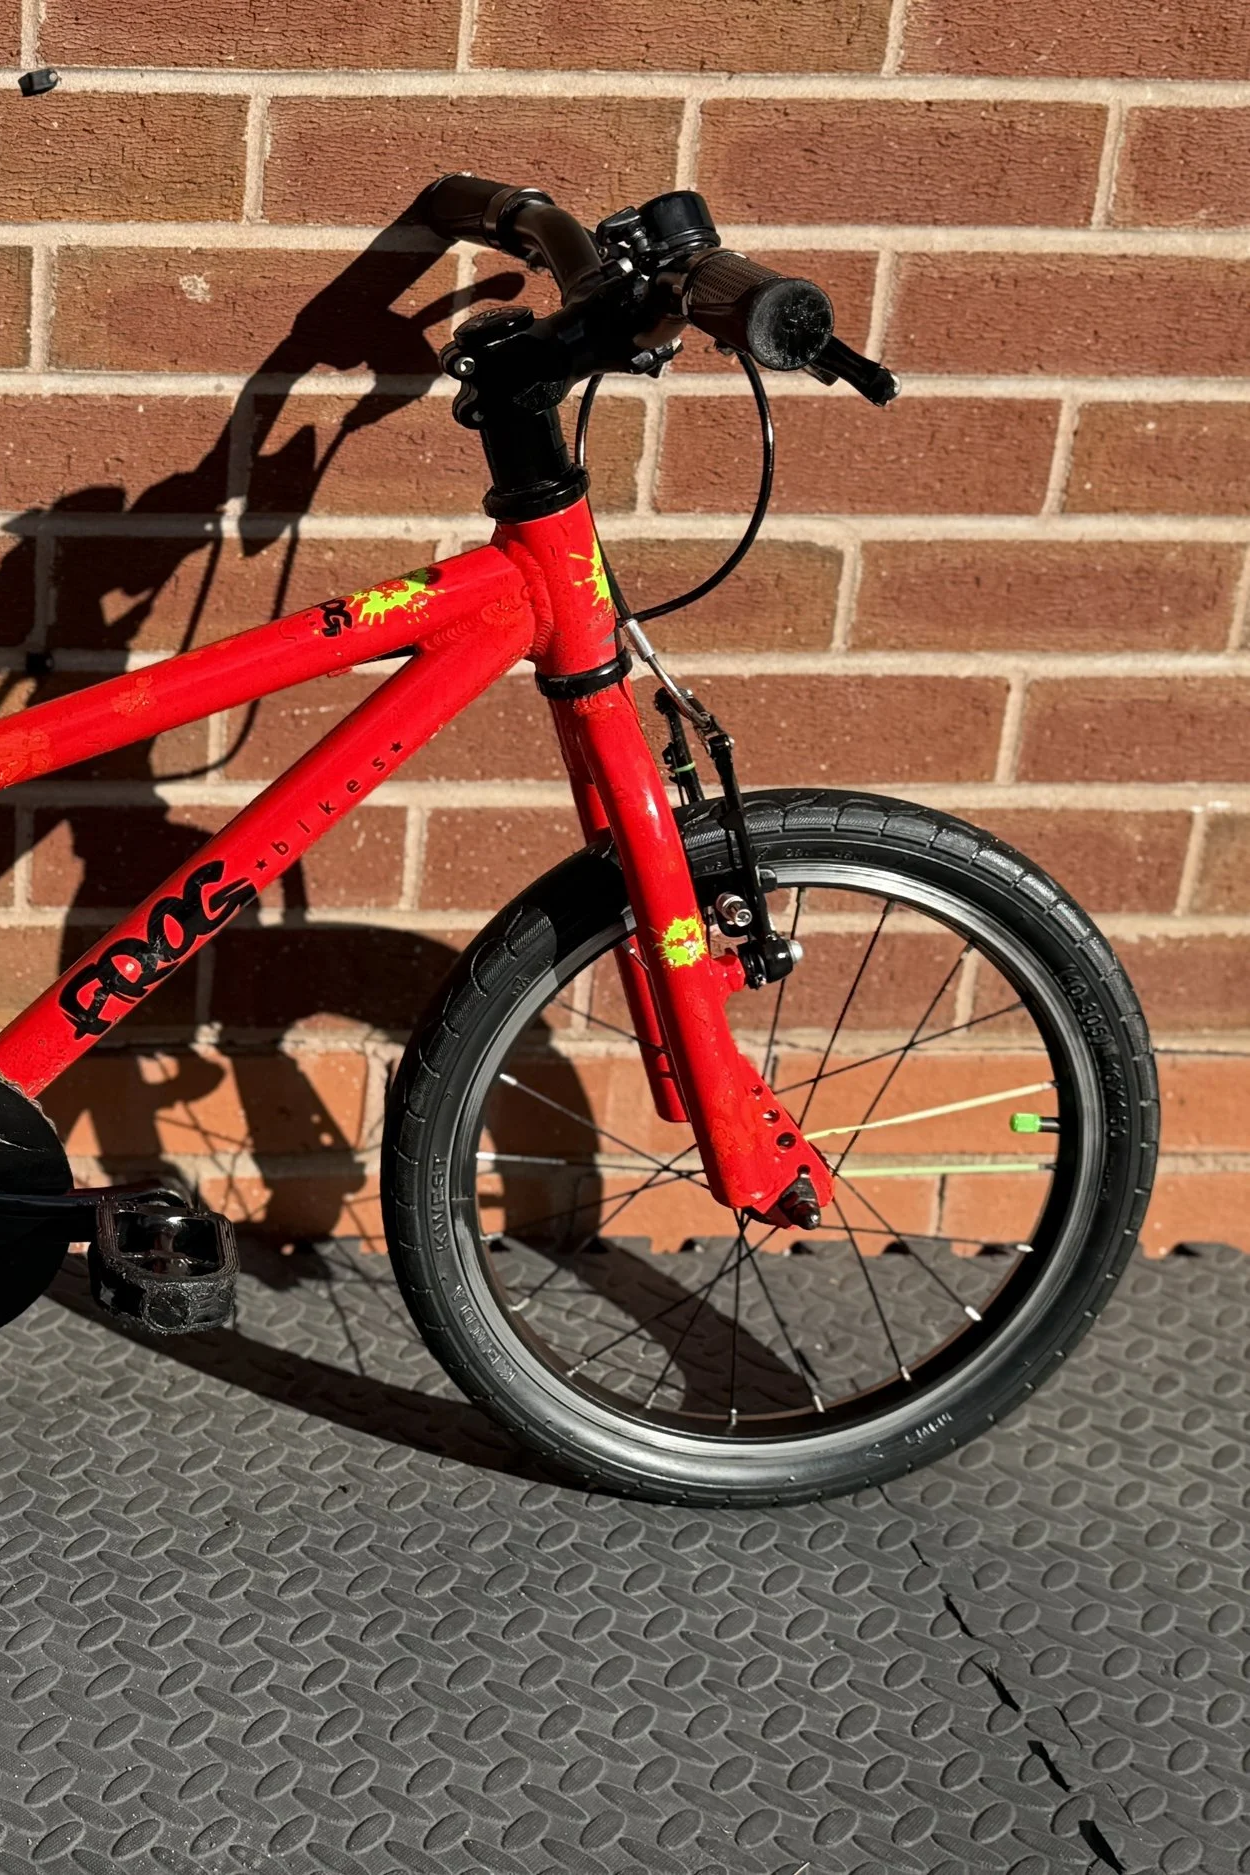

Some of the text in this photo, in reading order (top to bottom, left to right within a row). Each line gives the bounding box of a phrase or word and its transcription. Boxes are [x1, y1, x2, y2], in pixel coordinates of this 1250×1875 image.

[273, 756, 387, 856] bikes
[58, 860, 258, 1040] FROG
[430, 1153, 518, 1385] KENDA KWEST
